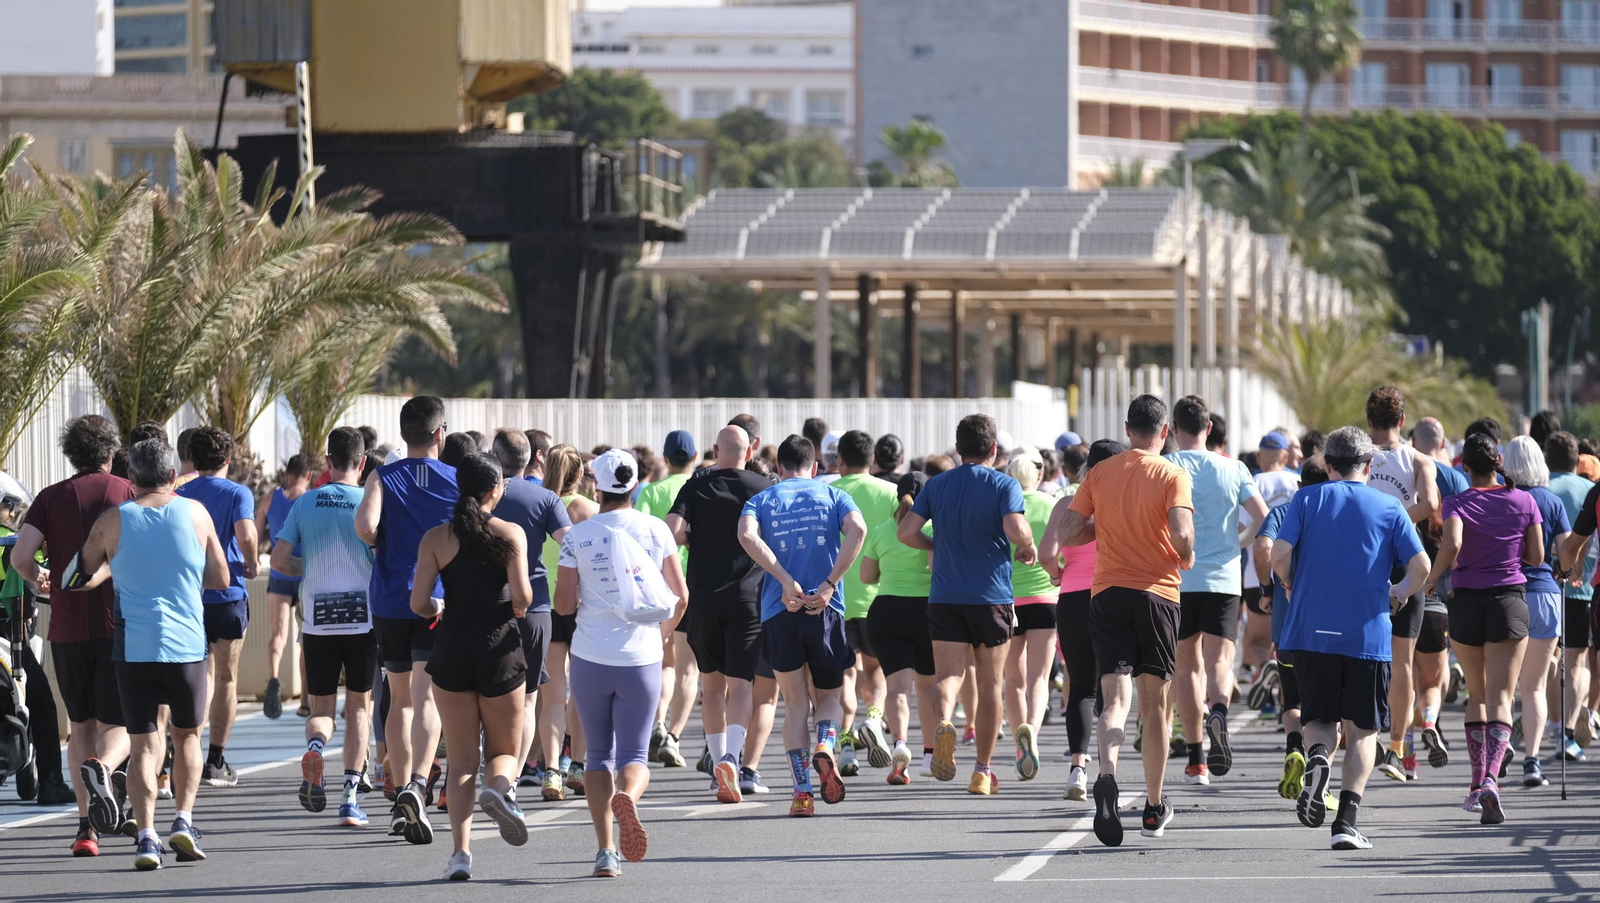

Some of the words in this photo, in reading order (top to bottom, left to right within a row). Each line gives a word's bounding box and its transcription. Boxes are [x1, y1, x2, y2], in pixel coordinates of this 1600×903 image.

[1370, 473, 1410, 501] ATLETISMO
[316, 493, 344, 501] MEDIO
[315, 501, 356, 510] MARATÓN
[580, 539, 594, 549] COX
